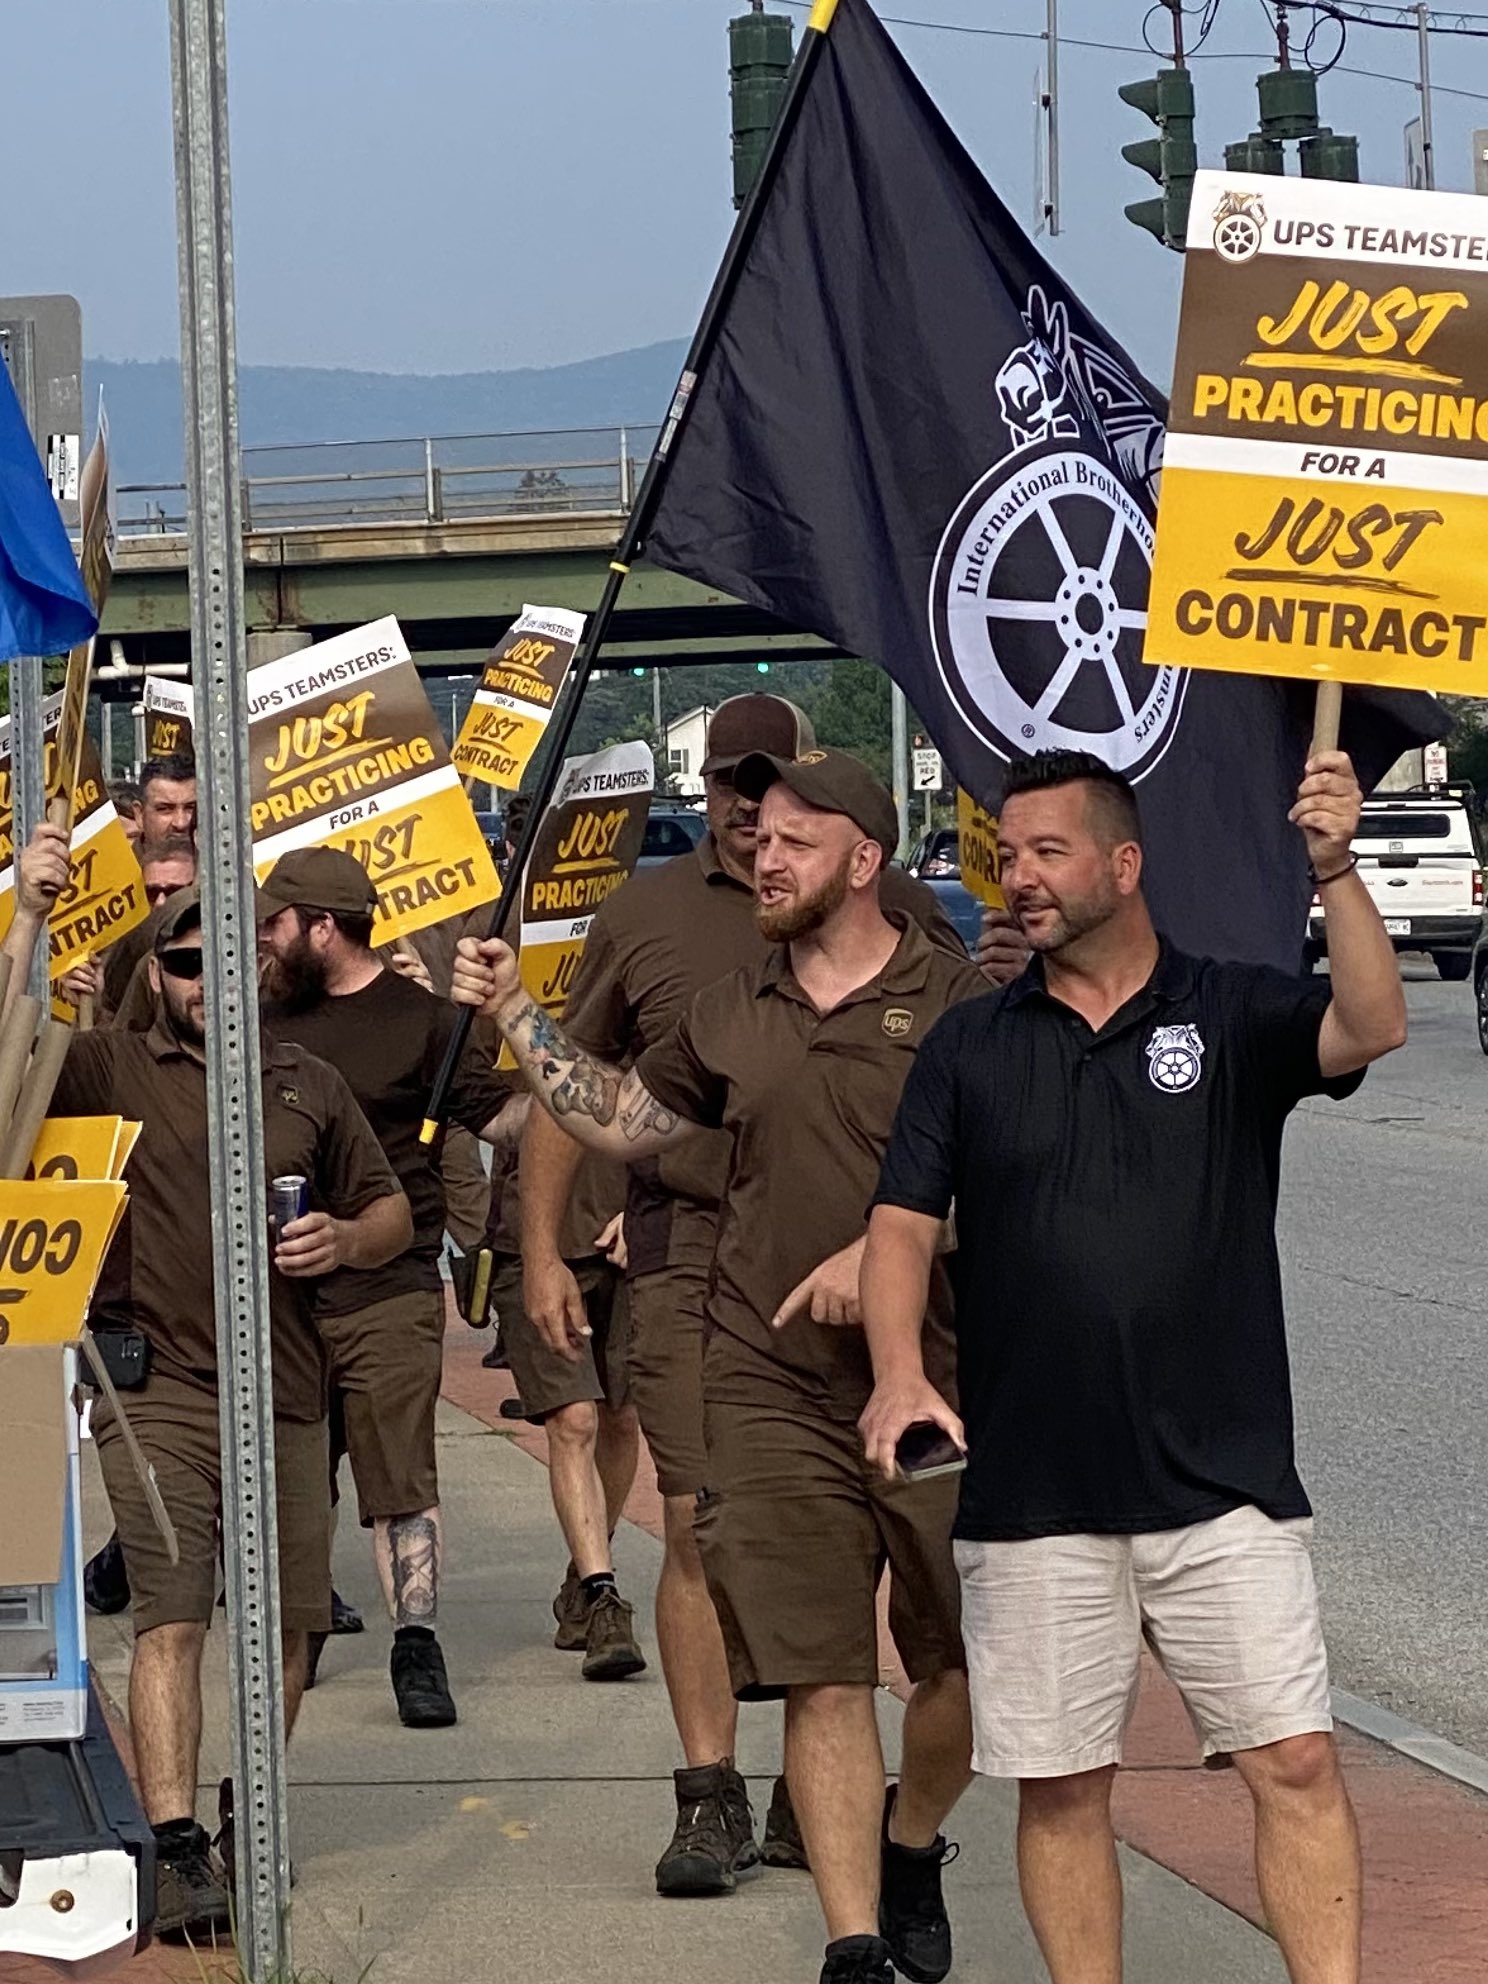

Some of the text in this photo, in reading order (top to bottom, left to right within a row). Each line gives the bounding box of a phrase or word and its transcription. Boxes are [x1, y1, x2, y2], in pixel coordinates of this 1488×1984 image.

[1273, 219, 1488, 261] UPS TEAMSTE
[1256, 280, 1469, 356] JUST
[1300, 451, 1385, 478] FOR A
[957, 460, 1155, 597] International Brotherho
[1234, 496, 1445, 572] JUST
[503, 637, 555, 667] JUST
[1175, 589, 1487, 662] CONTRACT
[248, 646, 397, 715] UPS TEAMSTERS:
[484, 667, 554, 703] PRACTICING
[264, 690, 375, 772] JUST
[472, 711, 524, 742] JUST
[251, 736, 435, 831] PRACTICING
[453, 743, 519, 776] CONTRACT
[329, 800, 380, 830] FOR A
[345, 813, 423, 870] UST
[558, 808, 630, 860] JUST
[376, 856, 477, 922] TRACT
[48, 883, 136, 960] NTRACT
[884, 1015, 910, 1032] ups
